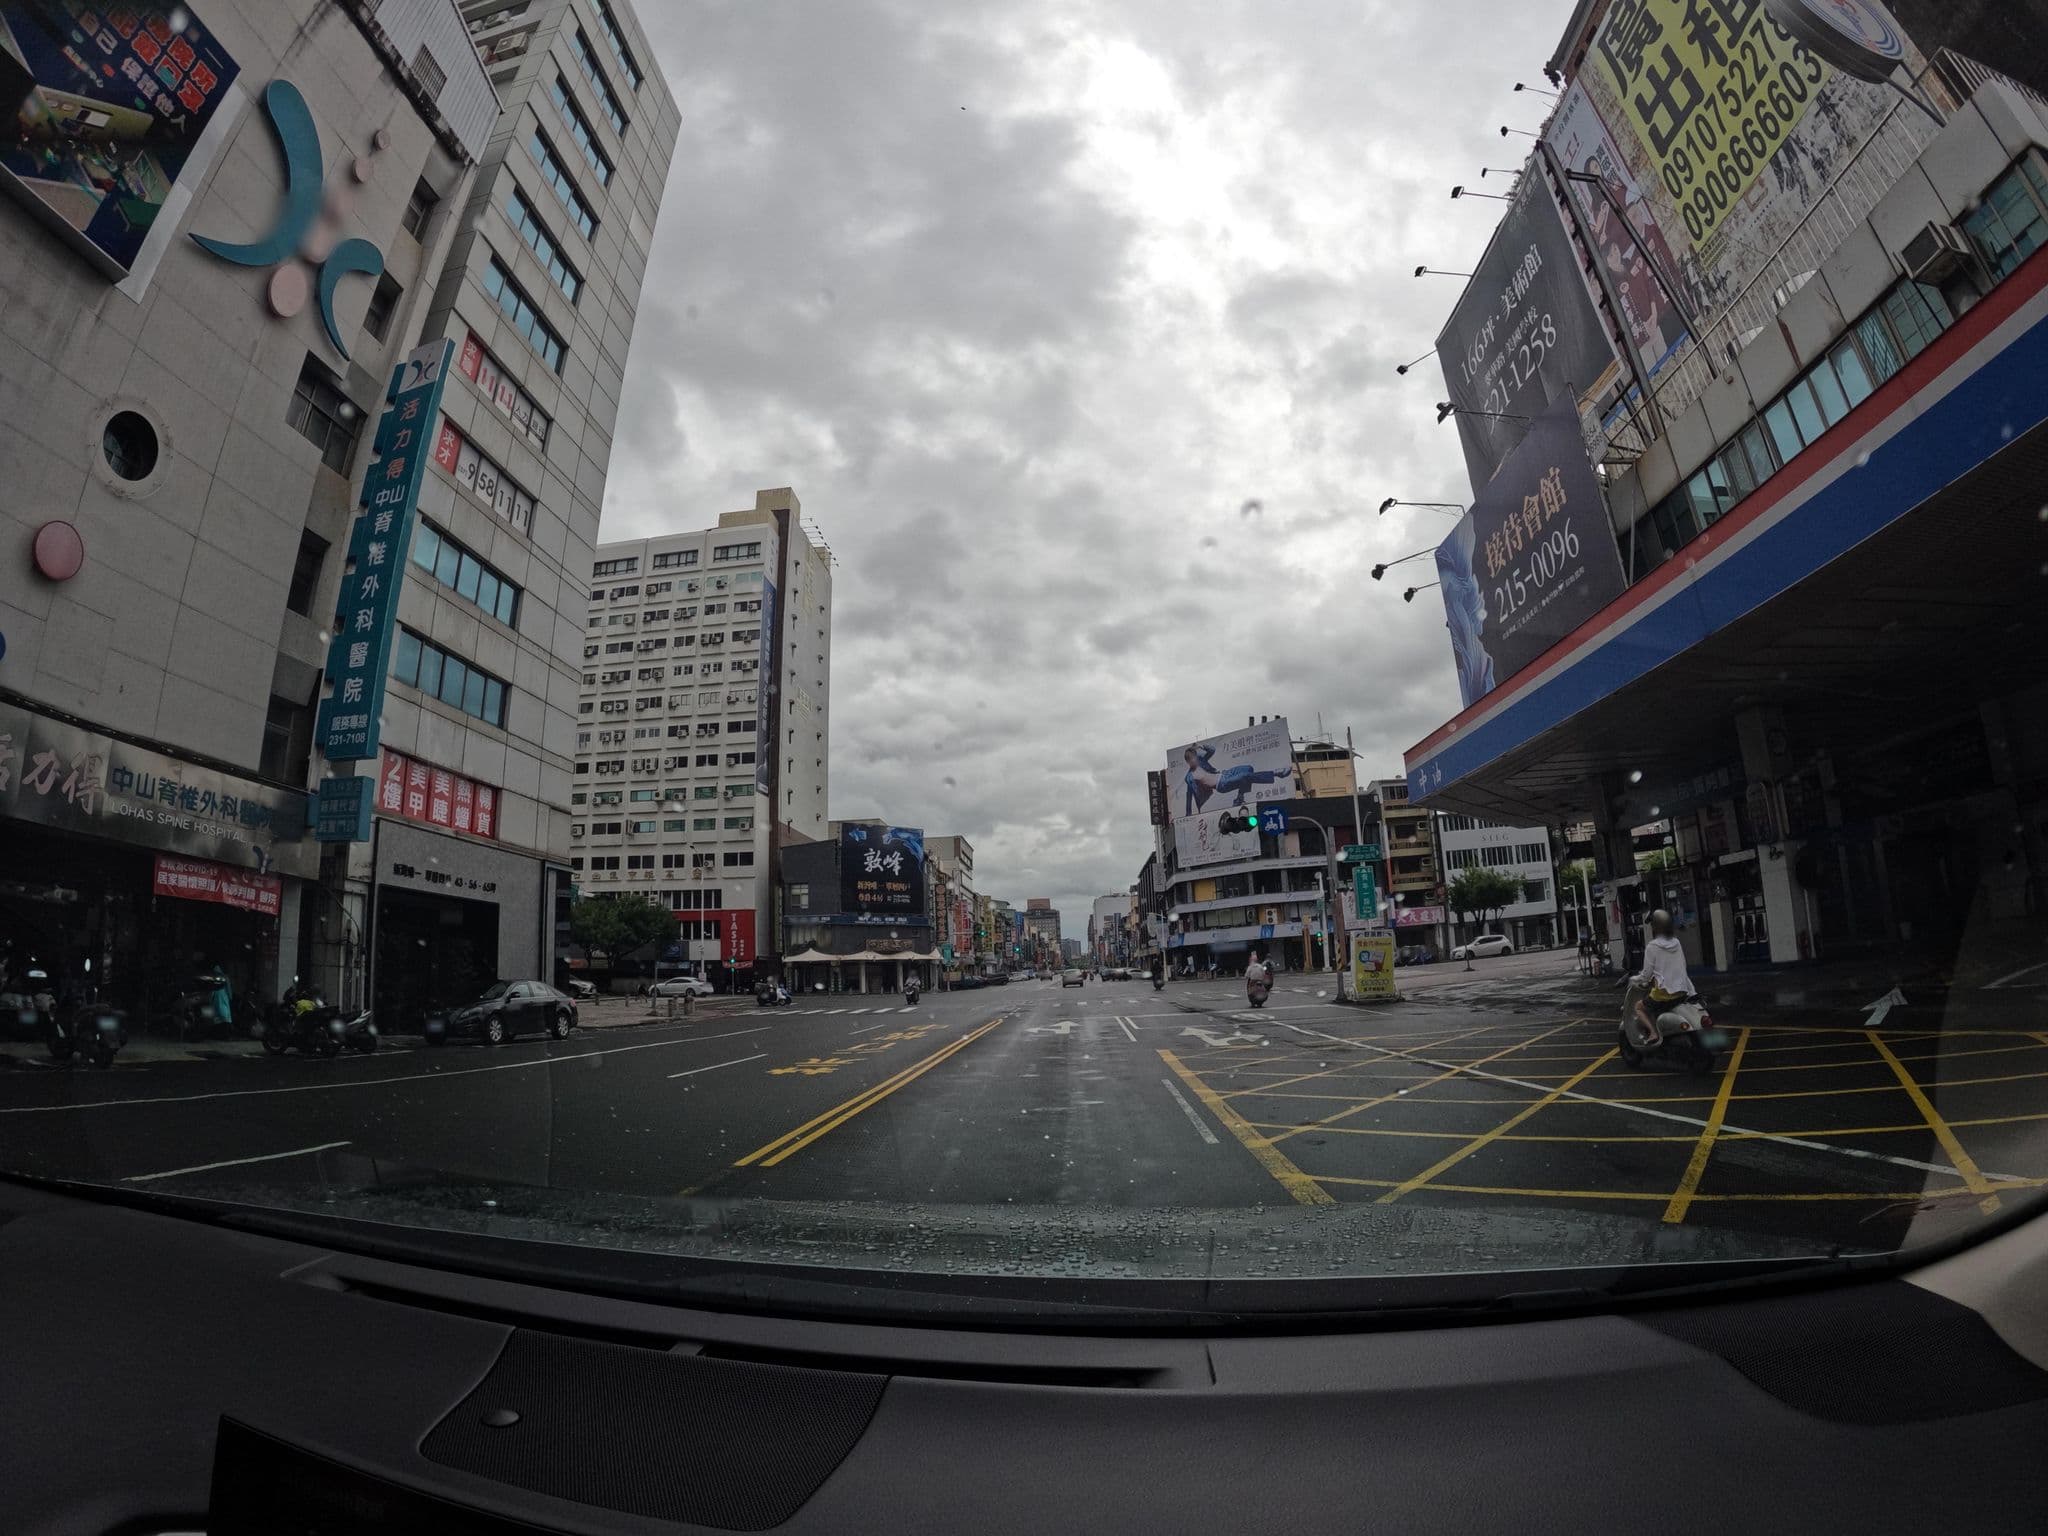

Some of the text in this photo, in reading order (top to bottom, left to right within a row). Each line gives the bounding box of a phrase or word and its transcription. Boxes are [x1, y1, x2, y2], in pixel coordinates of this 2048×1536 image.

[1682, 43, 1822, 241] 0906666603
[437, 429, 456, 465] 求才
[1484, 465, 1569, 579] 接待會館
[1494, 516, 1580, 625] 215-0096
[408, 762, 427, 817] 美甲
[1417, 761, 1442, 793] 中油
[110, 802, 249, 845] LOHAS SPINE HOSPITAL
[730, 913, 739, 957] TASTY
